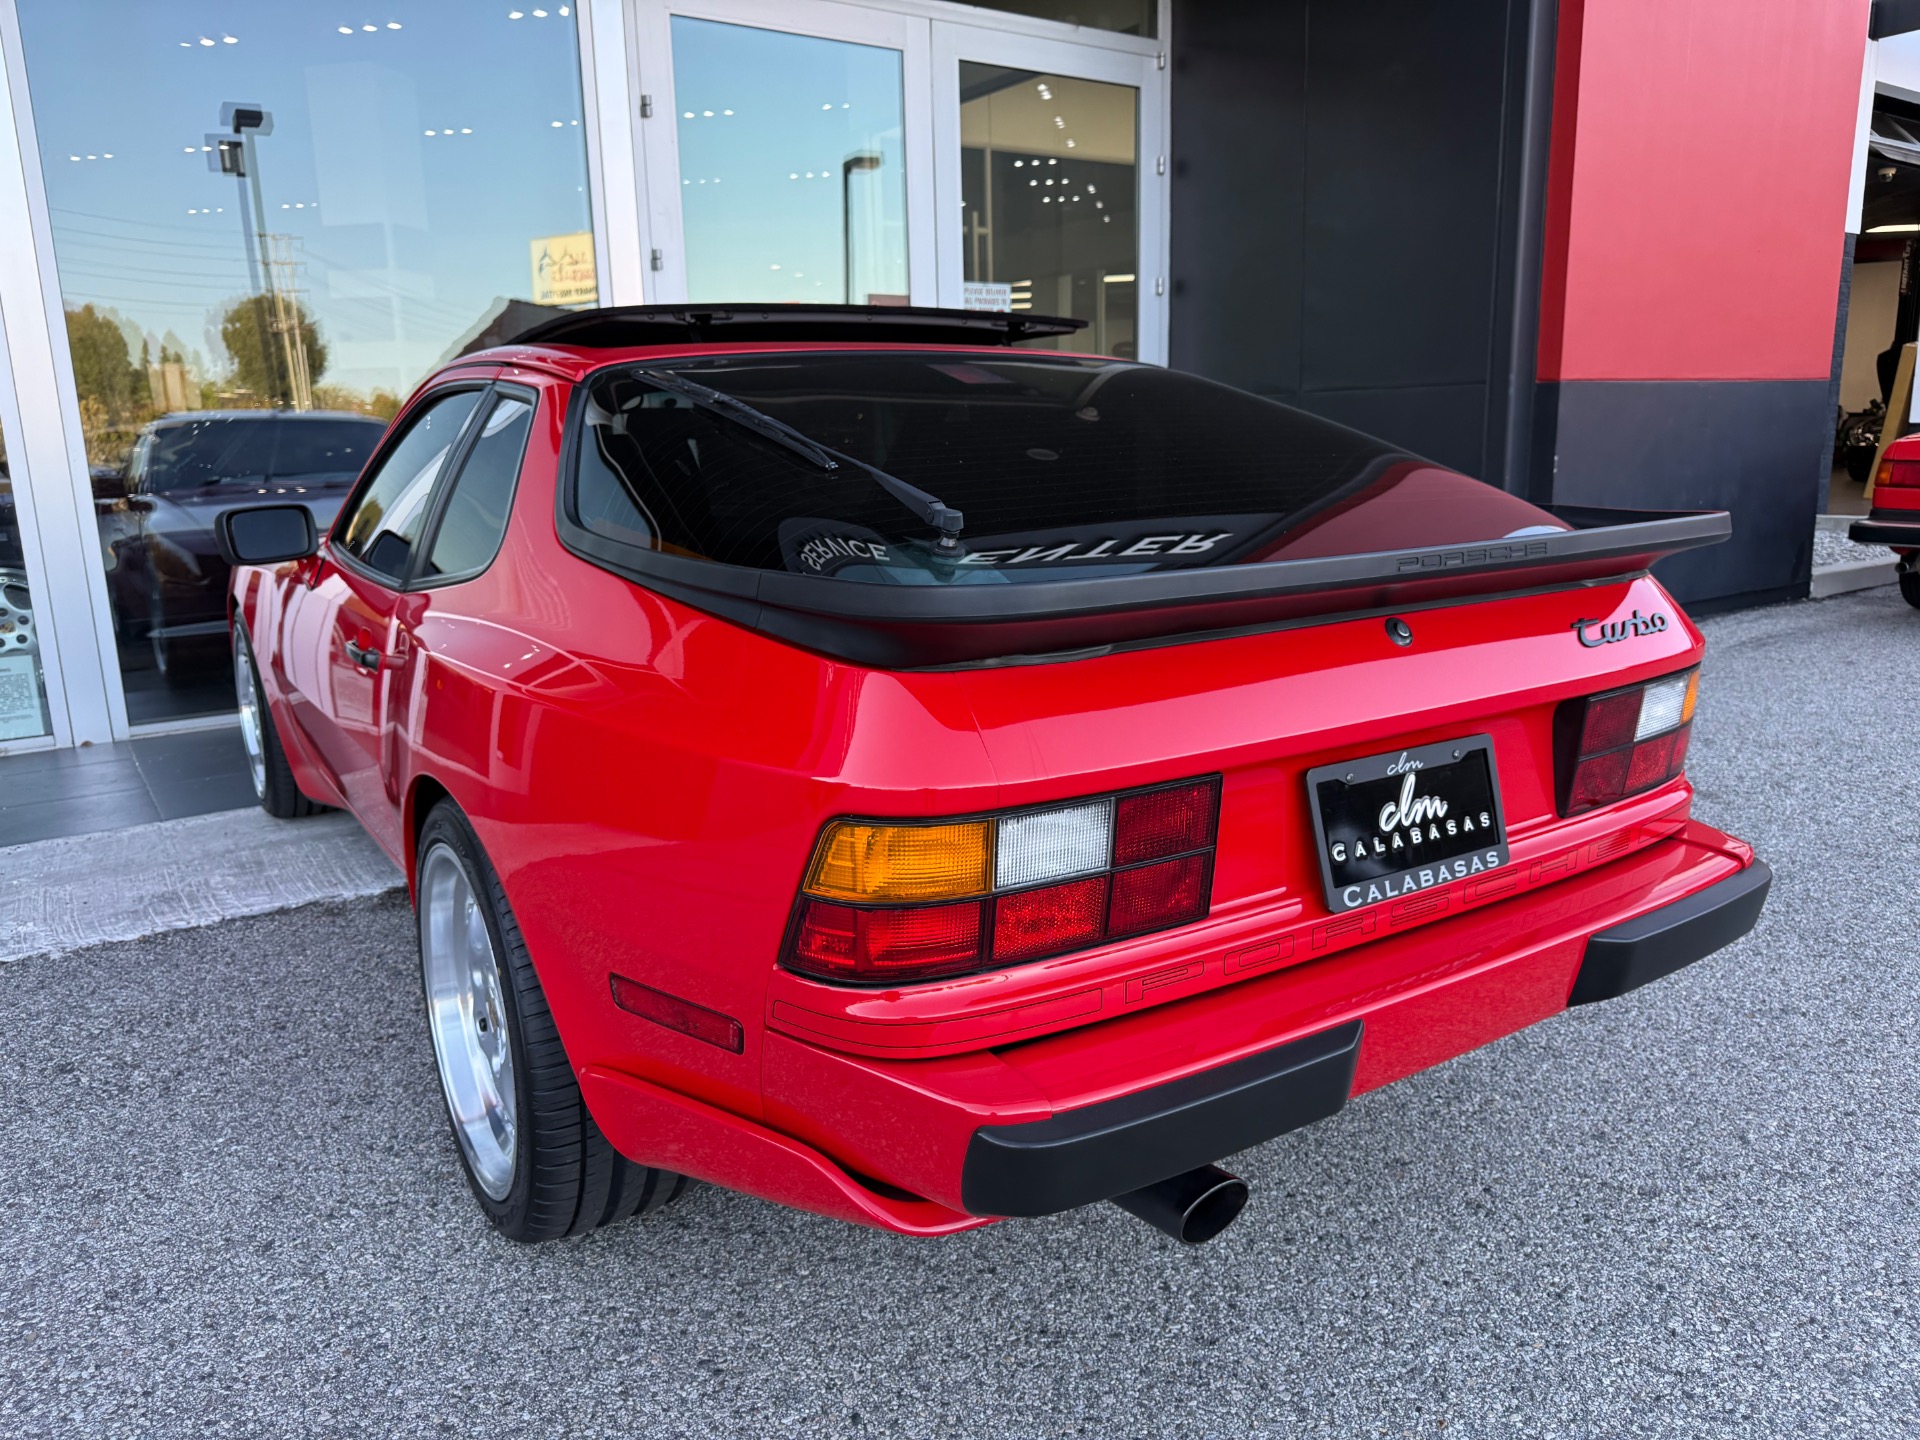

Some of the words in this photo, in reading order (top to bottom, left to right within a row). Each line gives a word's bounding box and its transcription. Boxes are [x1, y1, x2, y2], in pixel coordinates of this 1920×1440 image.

[1396, 542, 1548, 572] PORSCHE
[1332, 812, 1491, 862] CALABASAS
[1343, 851, 1500, 908] CALABASAS
[1124, 829, 1632, 1005] PORSCHE
